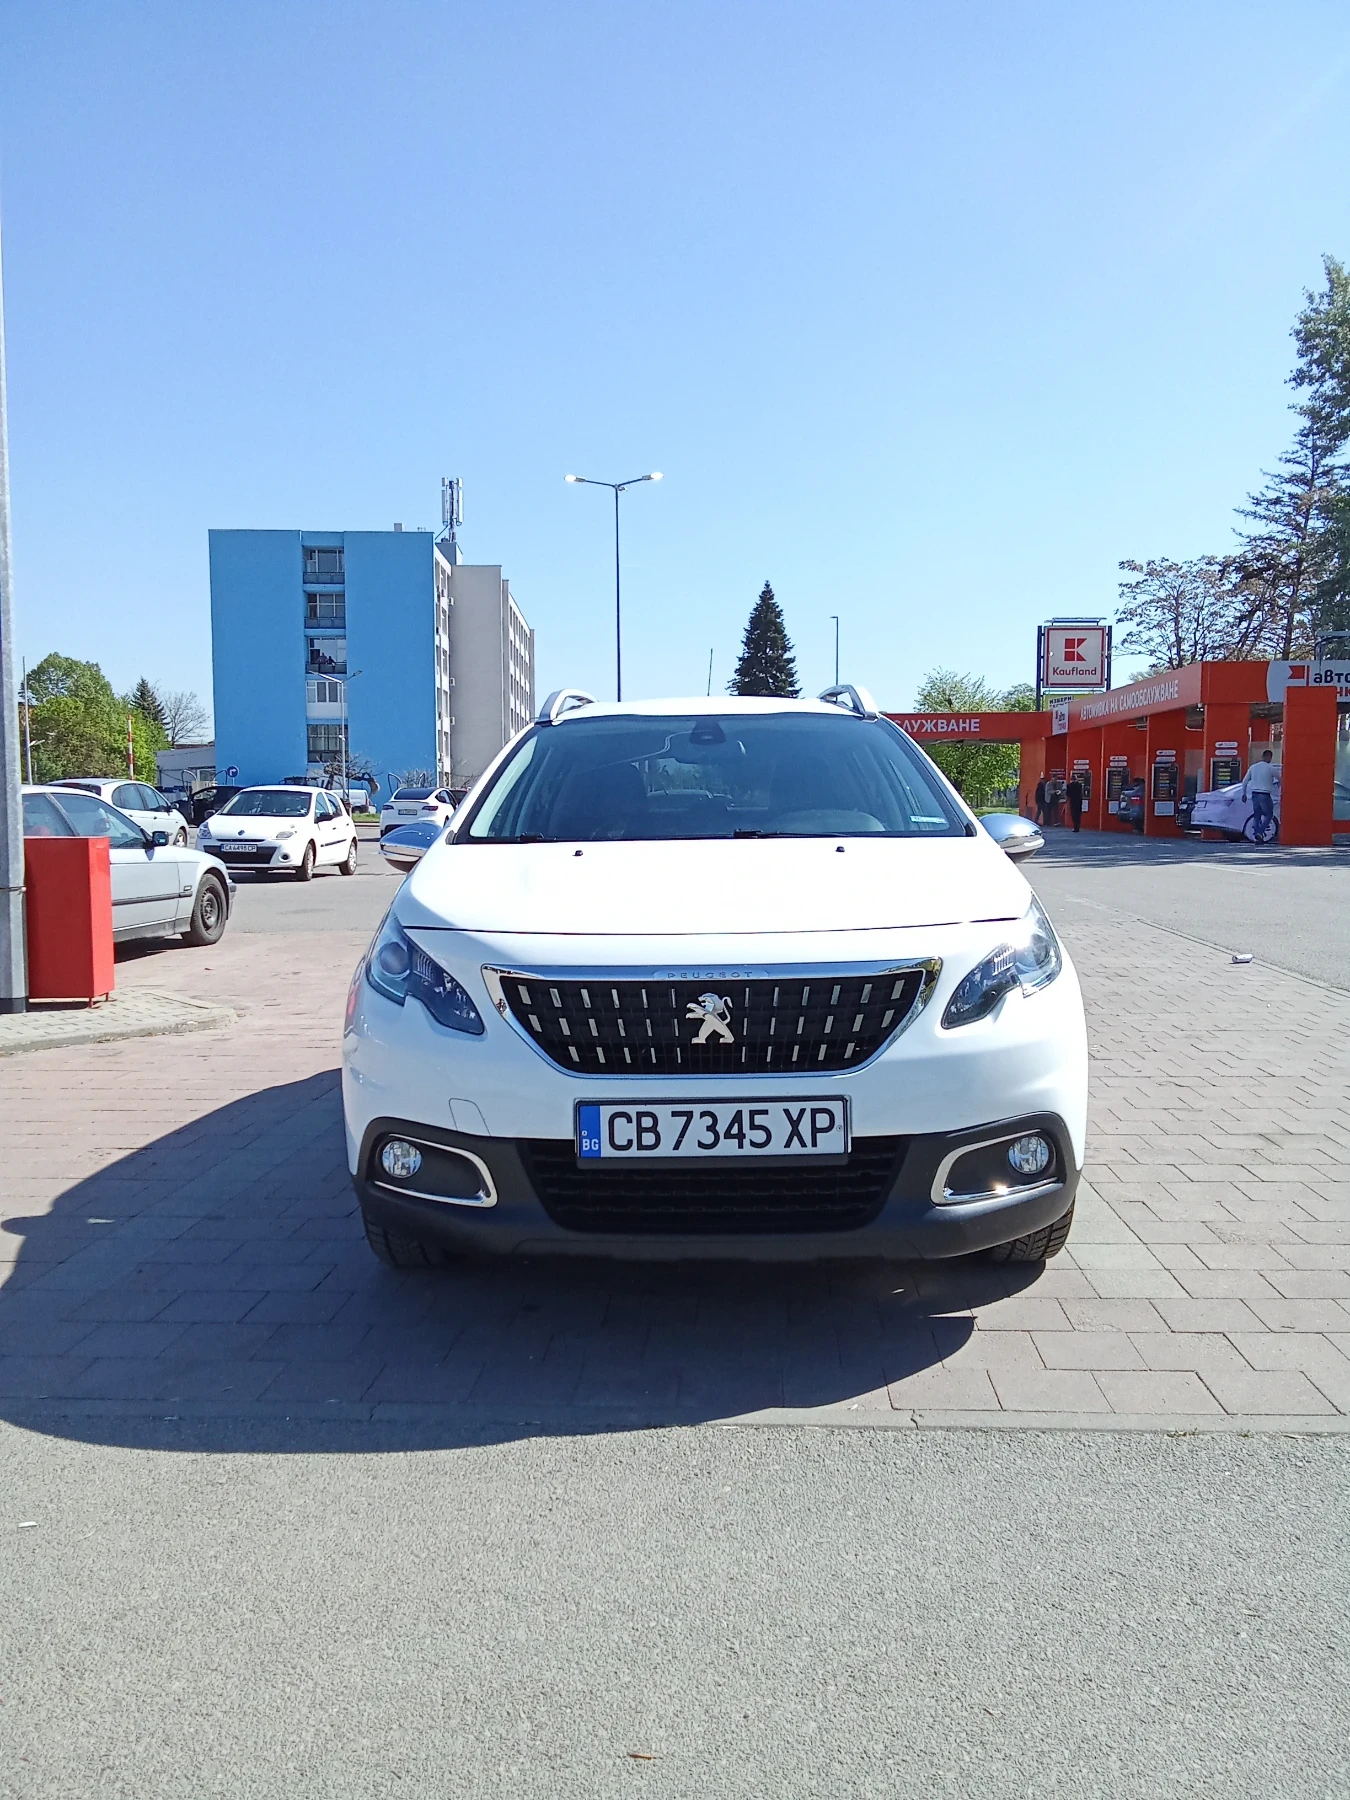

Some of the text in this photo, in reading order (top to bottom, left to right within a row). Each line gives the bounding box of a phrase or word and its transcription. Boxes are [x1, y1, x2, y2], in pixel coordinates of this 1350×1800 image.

[1053, 667, 1097, 676] Kaufland
[1110, 697, 1119, 713] НА
[1120, 680, 1179, 711] САМООБСЛУЖВАНЕ
[667, 971, 753, 979] PEUGEOT
[607, 1107, 836, 1151] CB 7345 XP
[582, 1138, 599, 1151] BG
